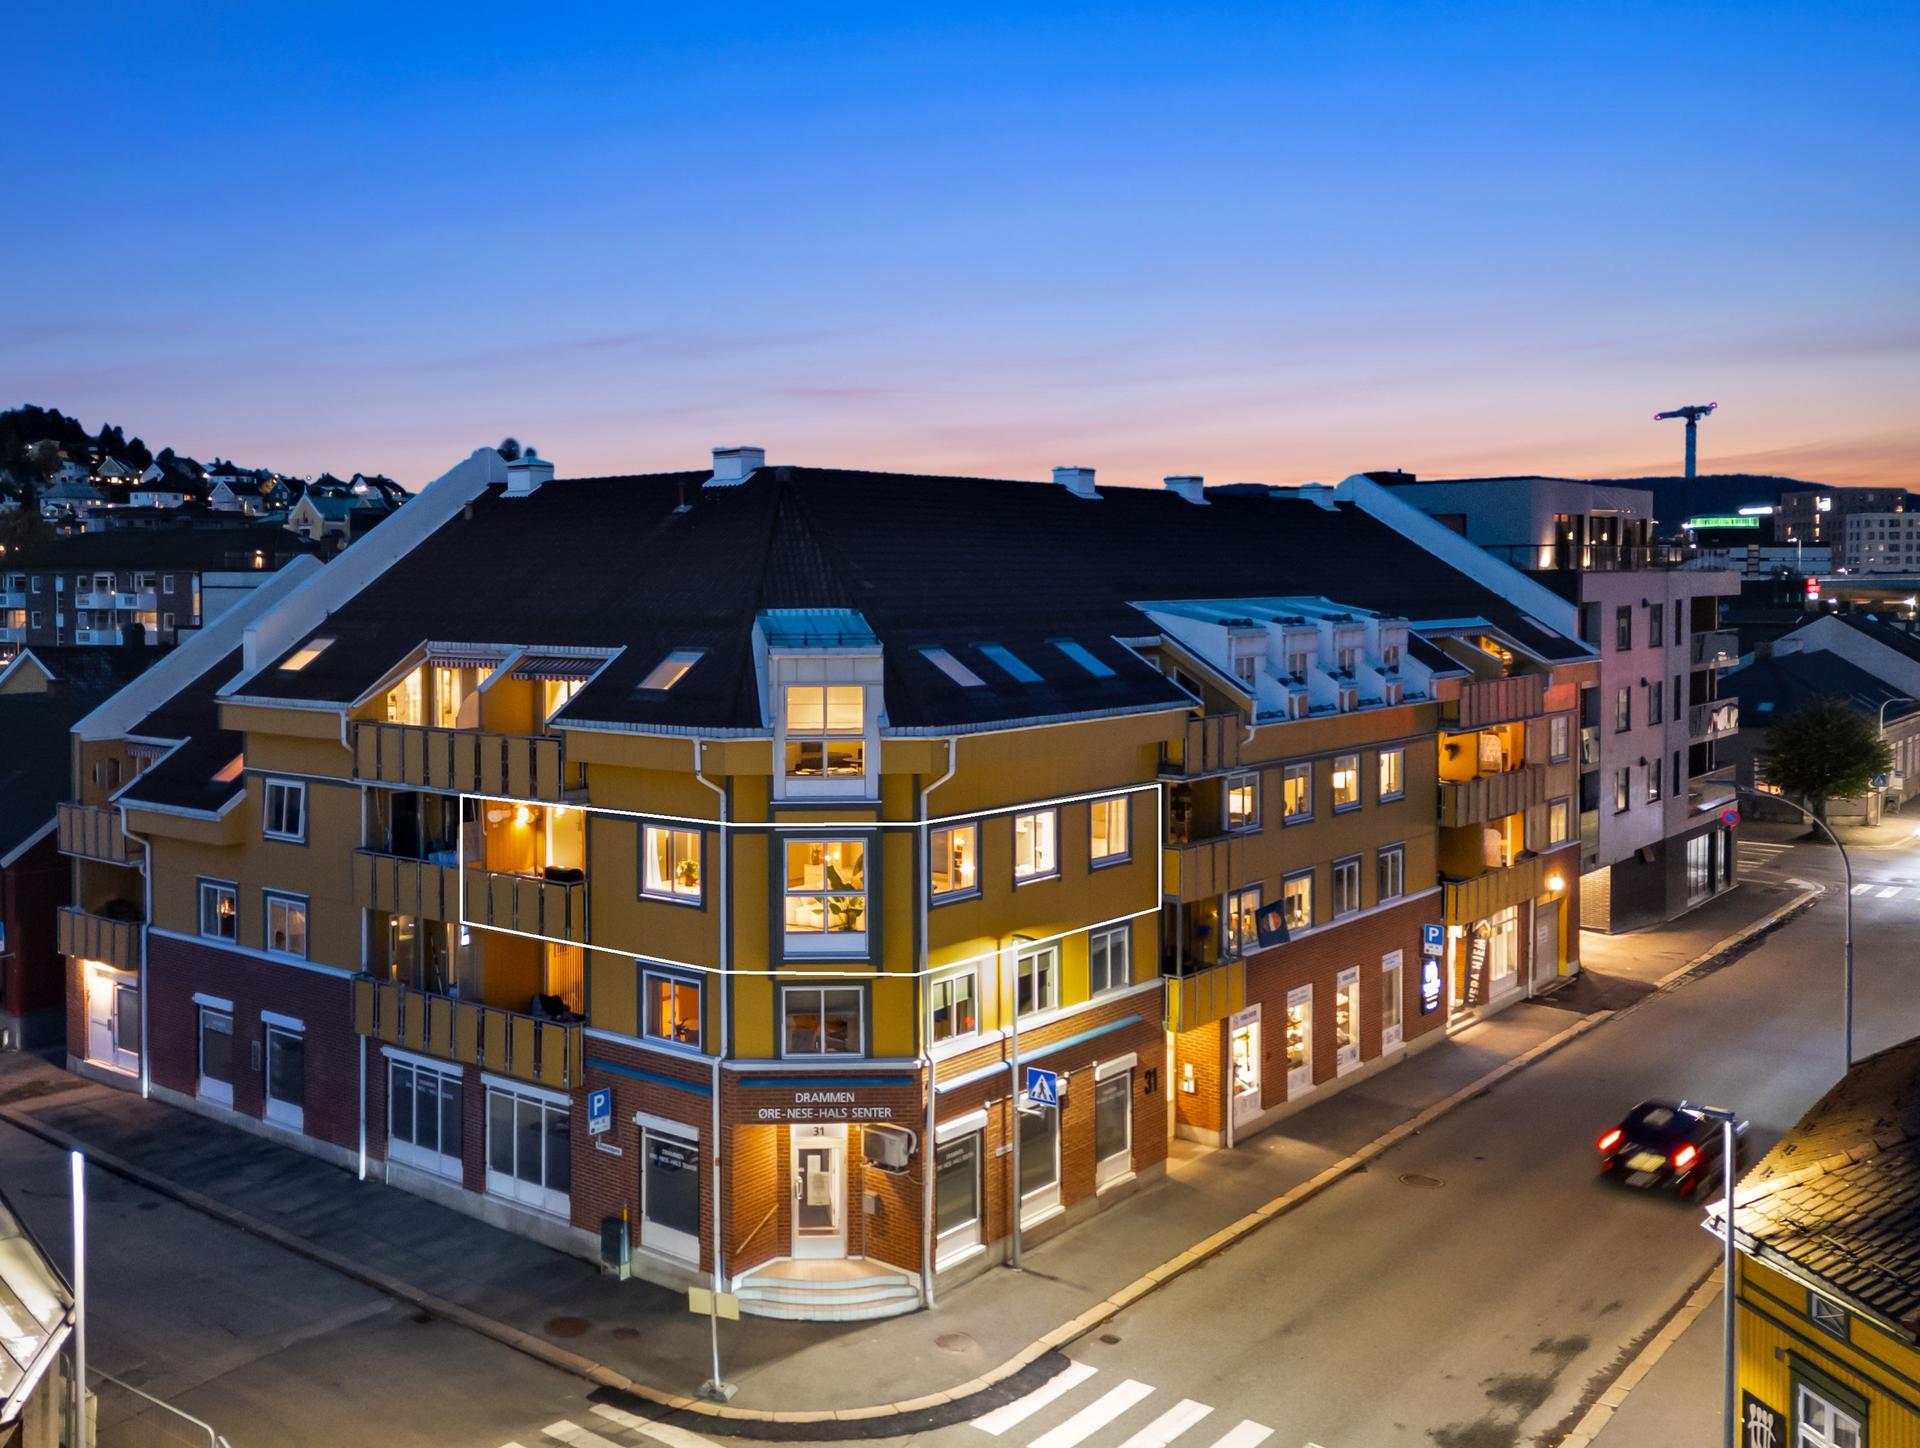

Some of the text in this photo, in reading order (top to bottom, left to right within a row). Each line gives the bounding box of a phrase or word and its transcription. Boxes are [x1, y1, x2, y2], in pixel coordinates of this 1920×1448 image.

[1429, 927, 1439, 942] P
[1145, 1068, 1157, 1094] 31
[795, 1092, 855, 1103] DRAMMEN
[594, 1094, 605, 1115] P
[758, 1107, 892, 1119] ØRE-NESE-HALS SENTER
[813, 1127, 825, 1136] 31
